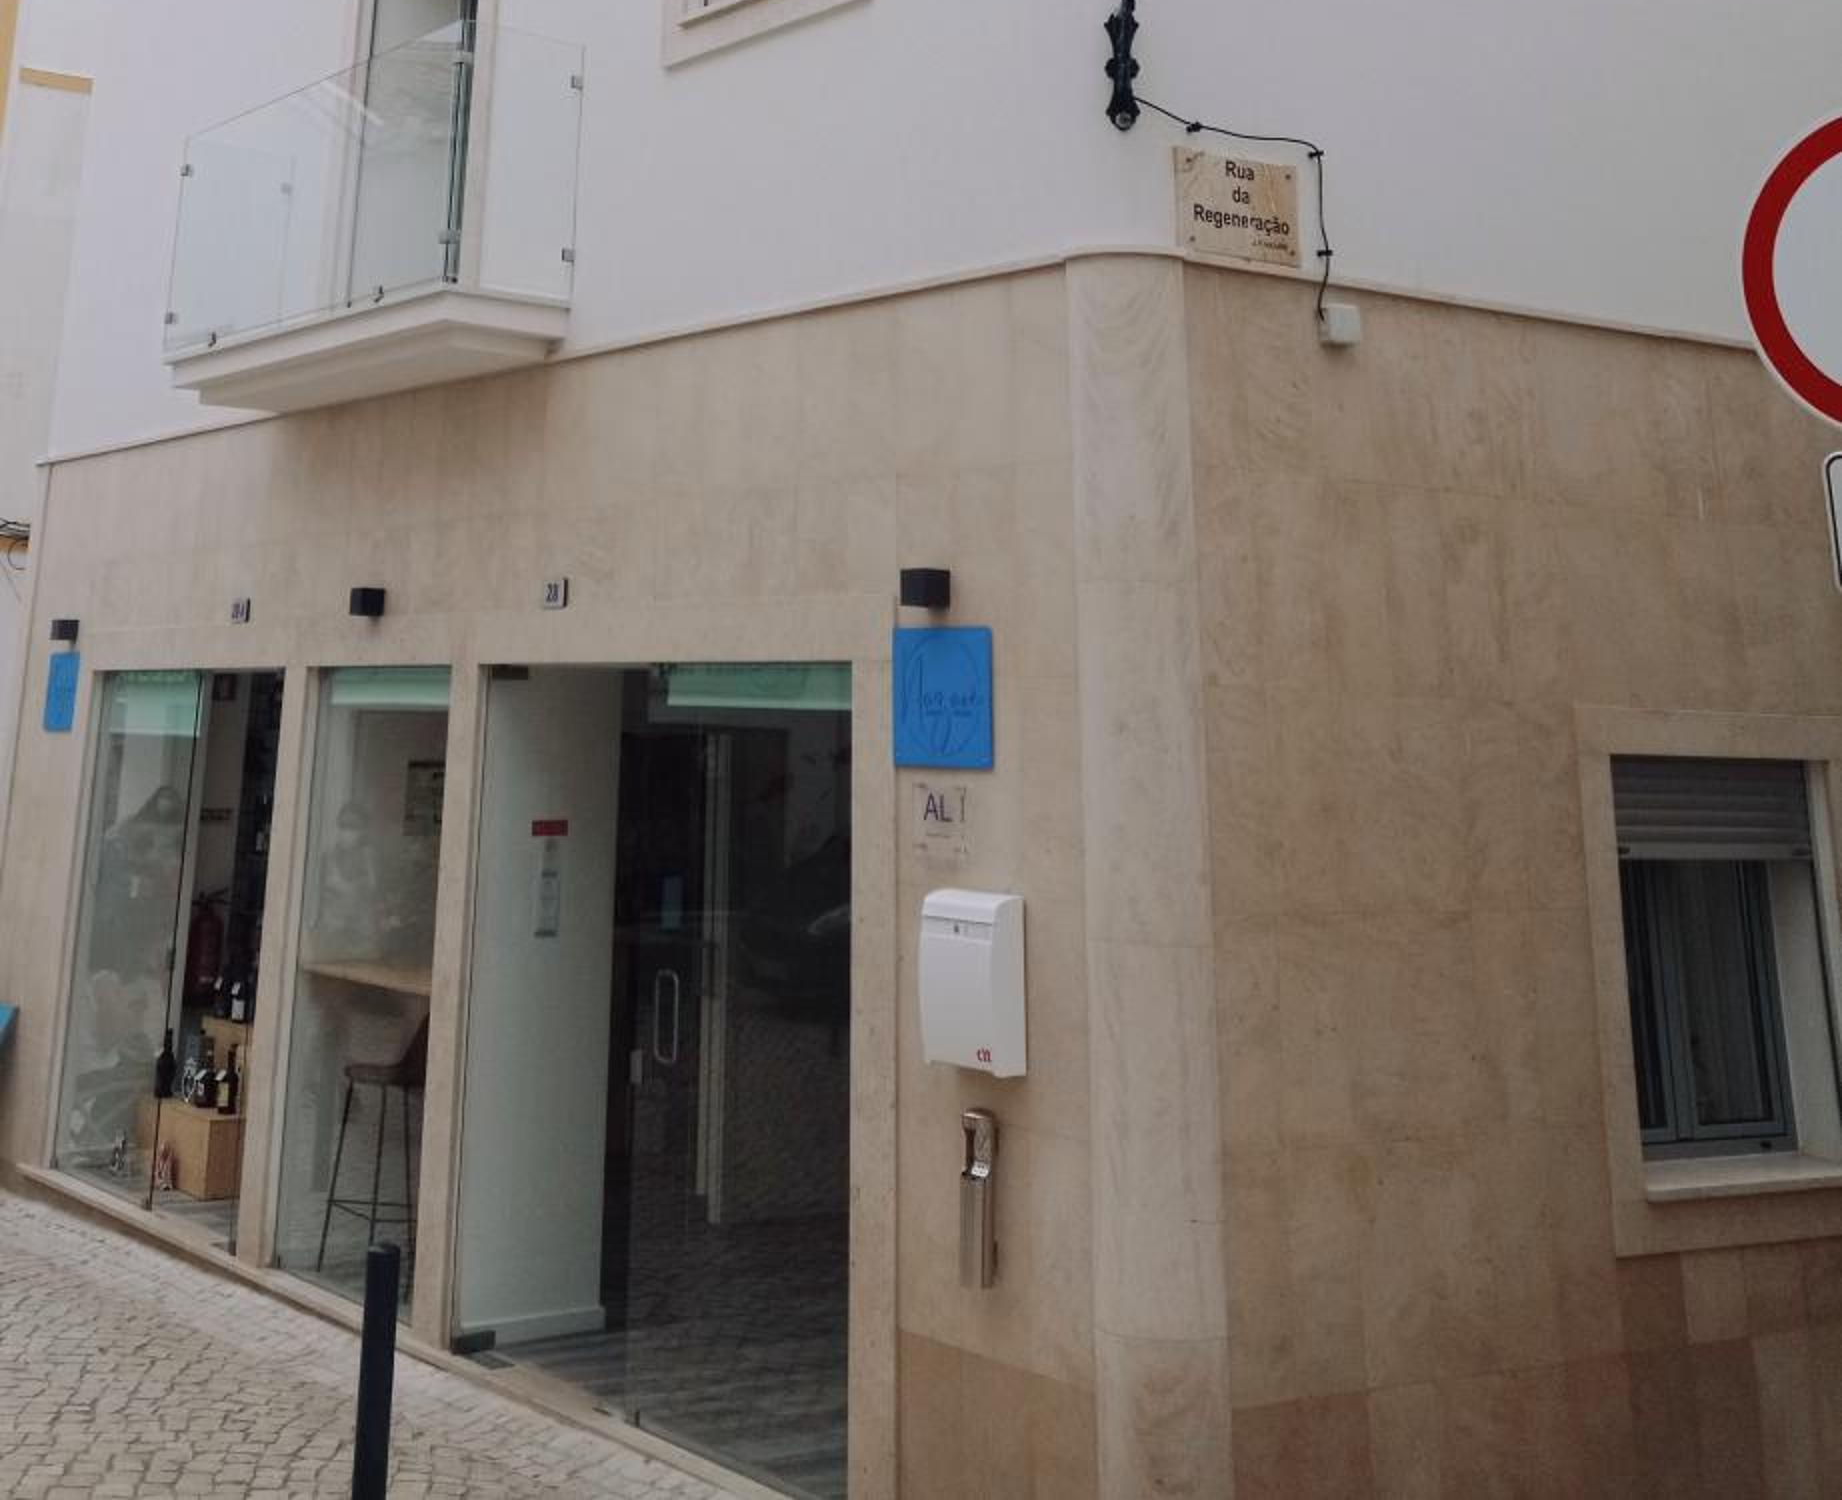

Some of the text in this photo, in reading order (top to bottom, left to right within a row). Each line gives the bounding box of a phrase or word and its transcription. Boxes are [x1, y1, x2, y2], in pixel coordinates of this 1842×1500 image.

[1225, 159, 1255, 181] Rua
[1232, 186, 1250, 204] da
[1193, 203, 1290, 236] Regeneração
[923, 792, 953, 823] AL
